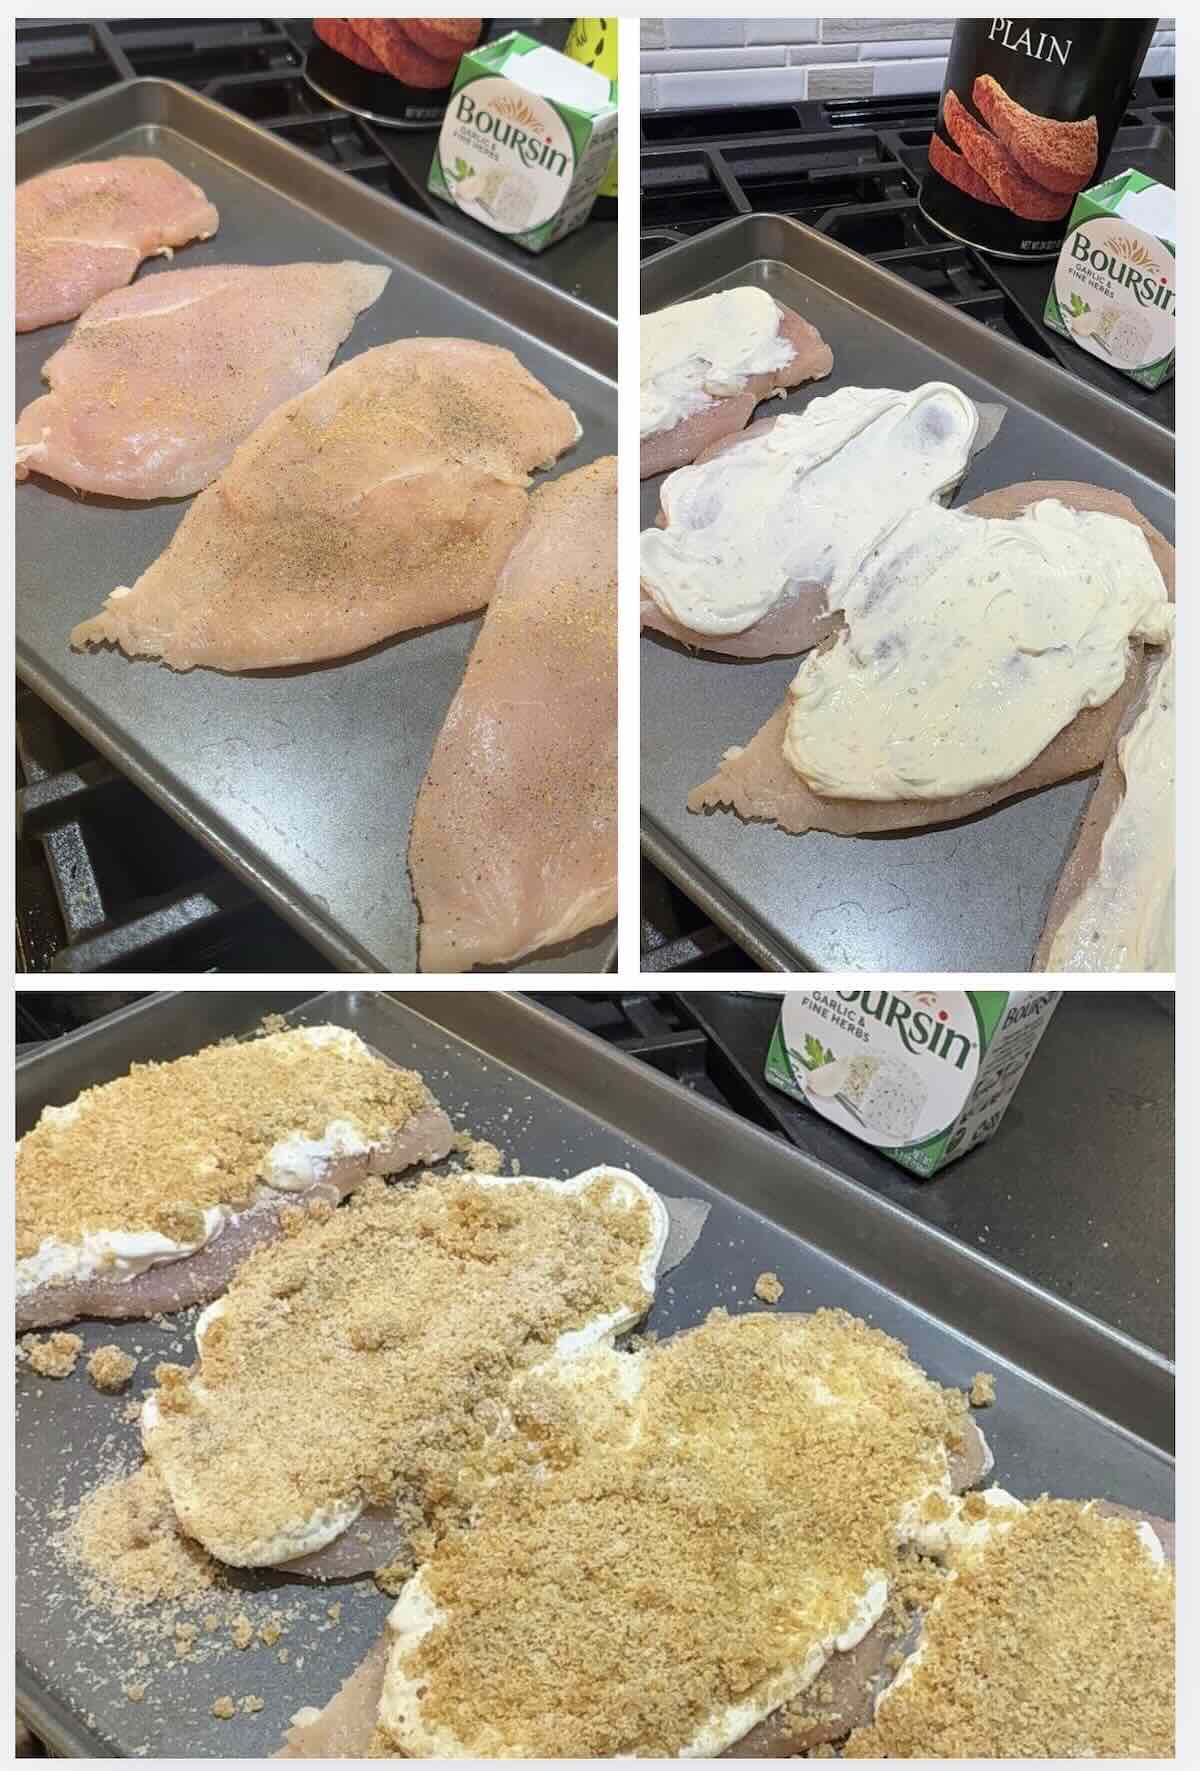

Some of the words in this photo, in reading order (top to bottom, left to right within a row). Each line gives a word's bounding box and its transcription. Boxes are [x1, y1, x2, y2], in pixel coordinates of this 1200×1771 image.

[988, 18, 1073, 66] PLAIN
[1068, 267, 1087, 282] FINE
[1088, 281, 1115, 299] HERBS
[1075, 263, 1105, 284] GARLIC
[801, 996, 830, 1019] FINE
[831, 1013, 871, 1043] HERBS
[812, 991, 857, 1022] GARLIC
[857, 1015, 865, 1028] &
